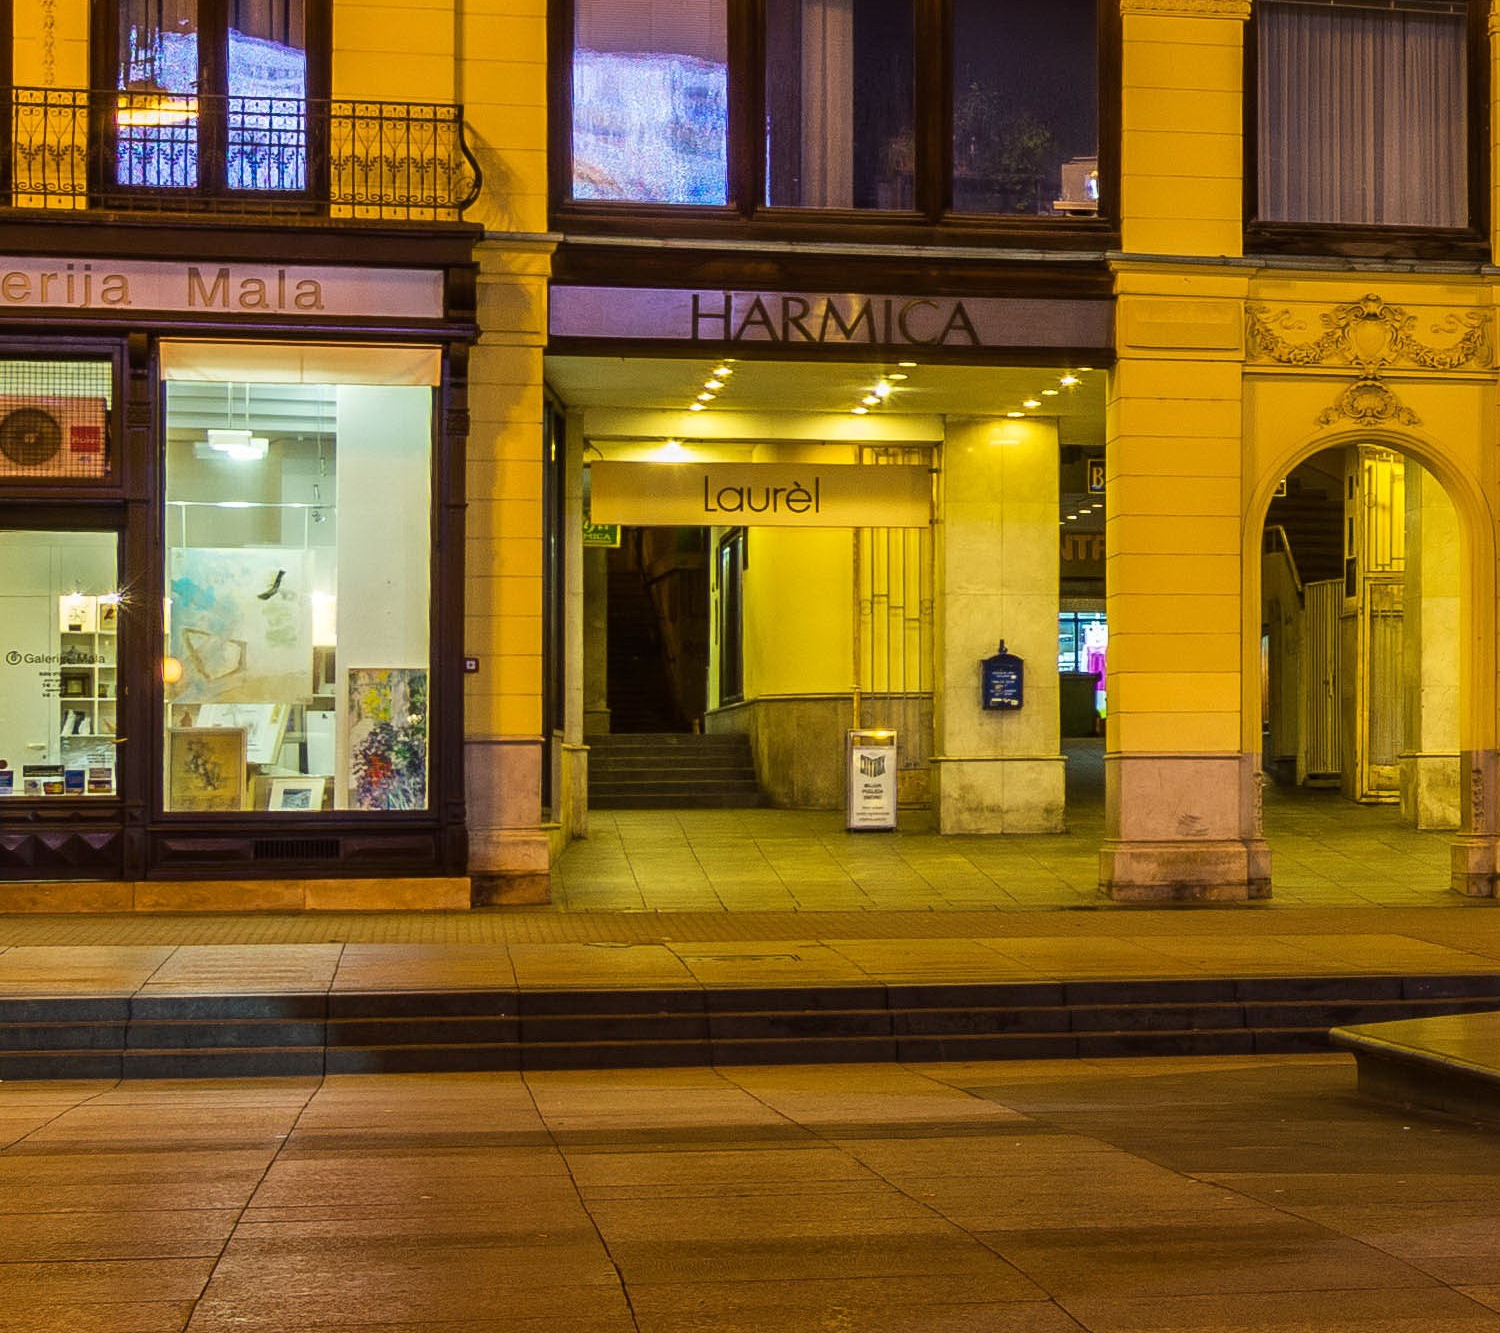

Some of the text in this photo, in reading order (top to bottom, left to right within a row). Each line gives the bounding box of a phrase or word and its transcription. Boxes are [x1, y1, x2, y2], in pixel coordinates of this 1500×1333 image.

[187, 267, 325, 310] Mala
[692, 293, 982, 346] HARMICA
[704, 475, 820, 514] Laurèl
